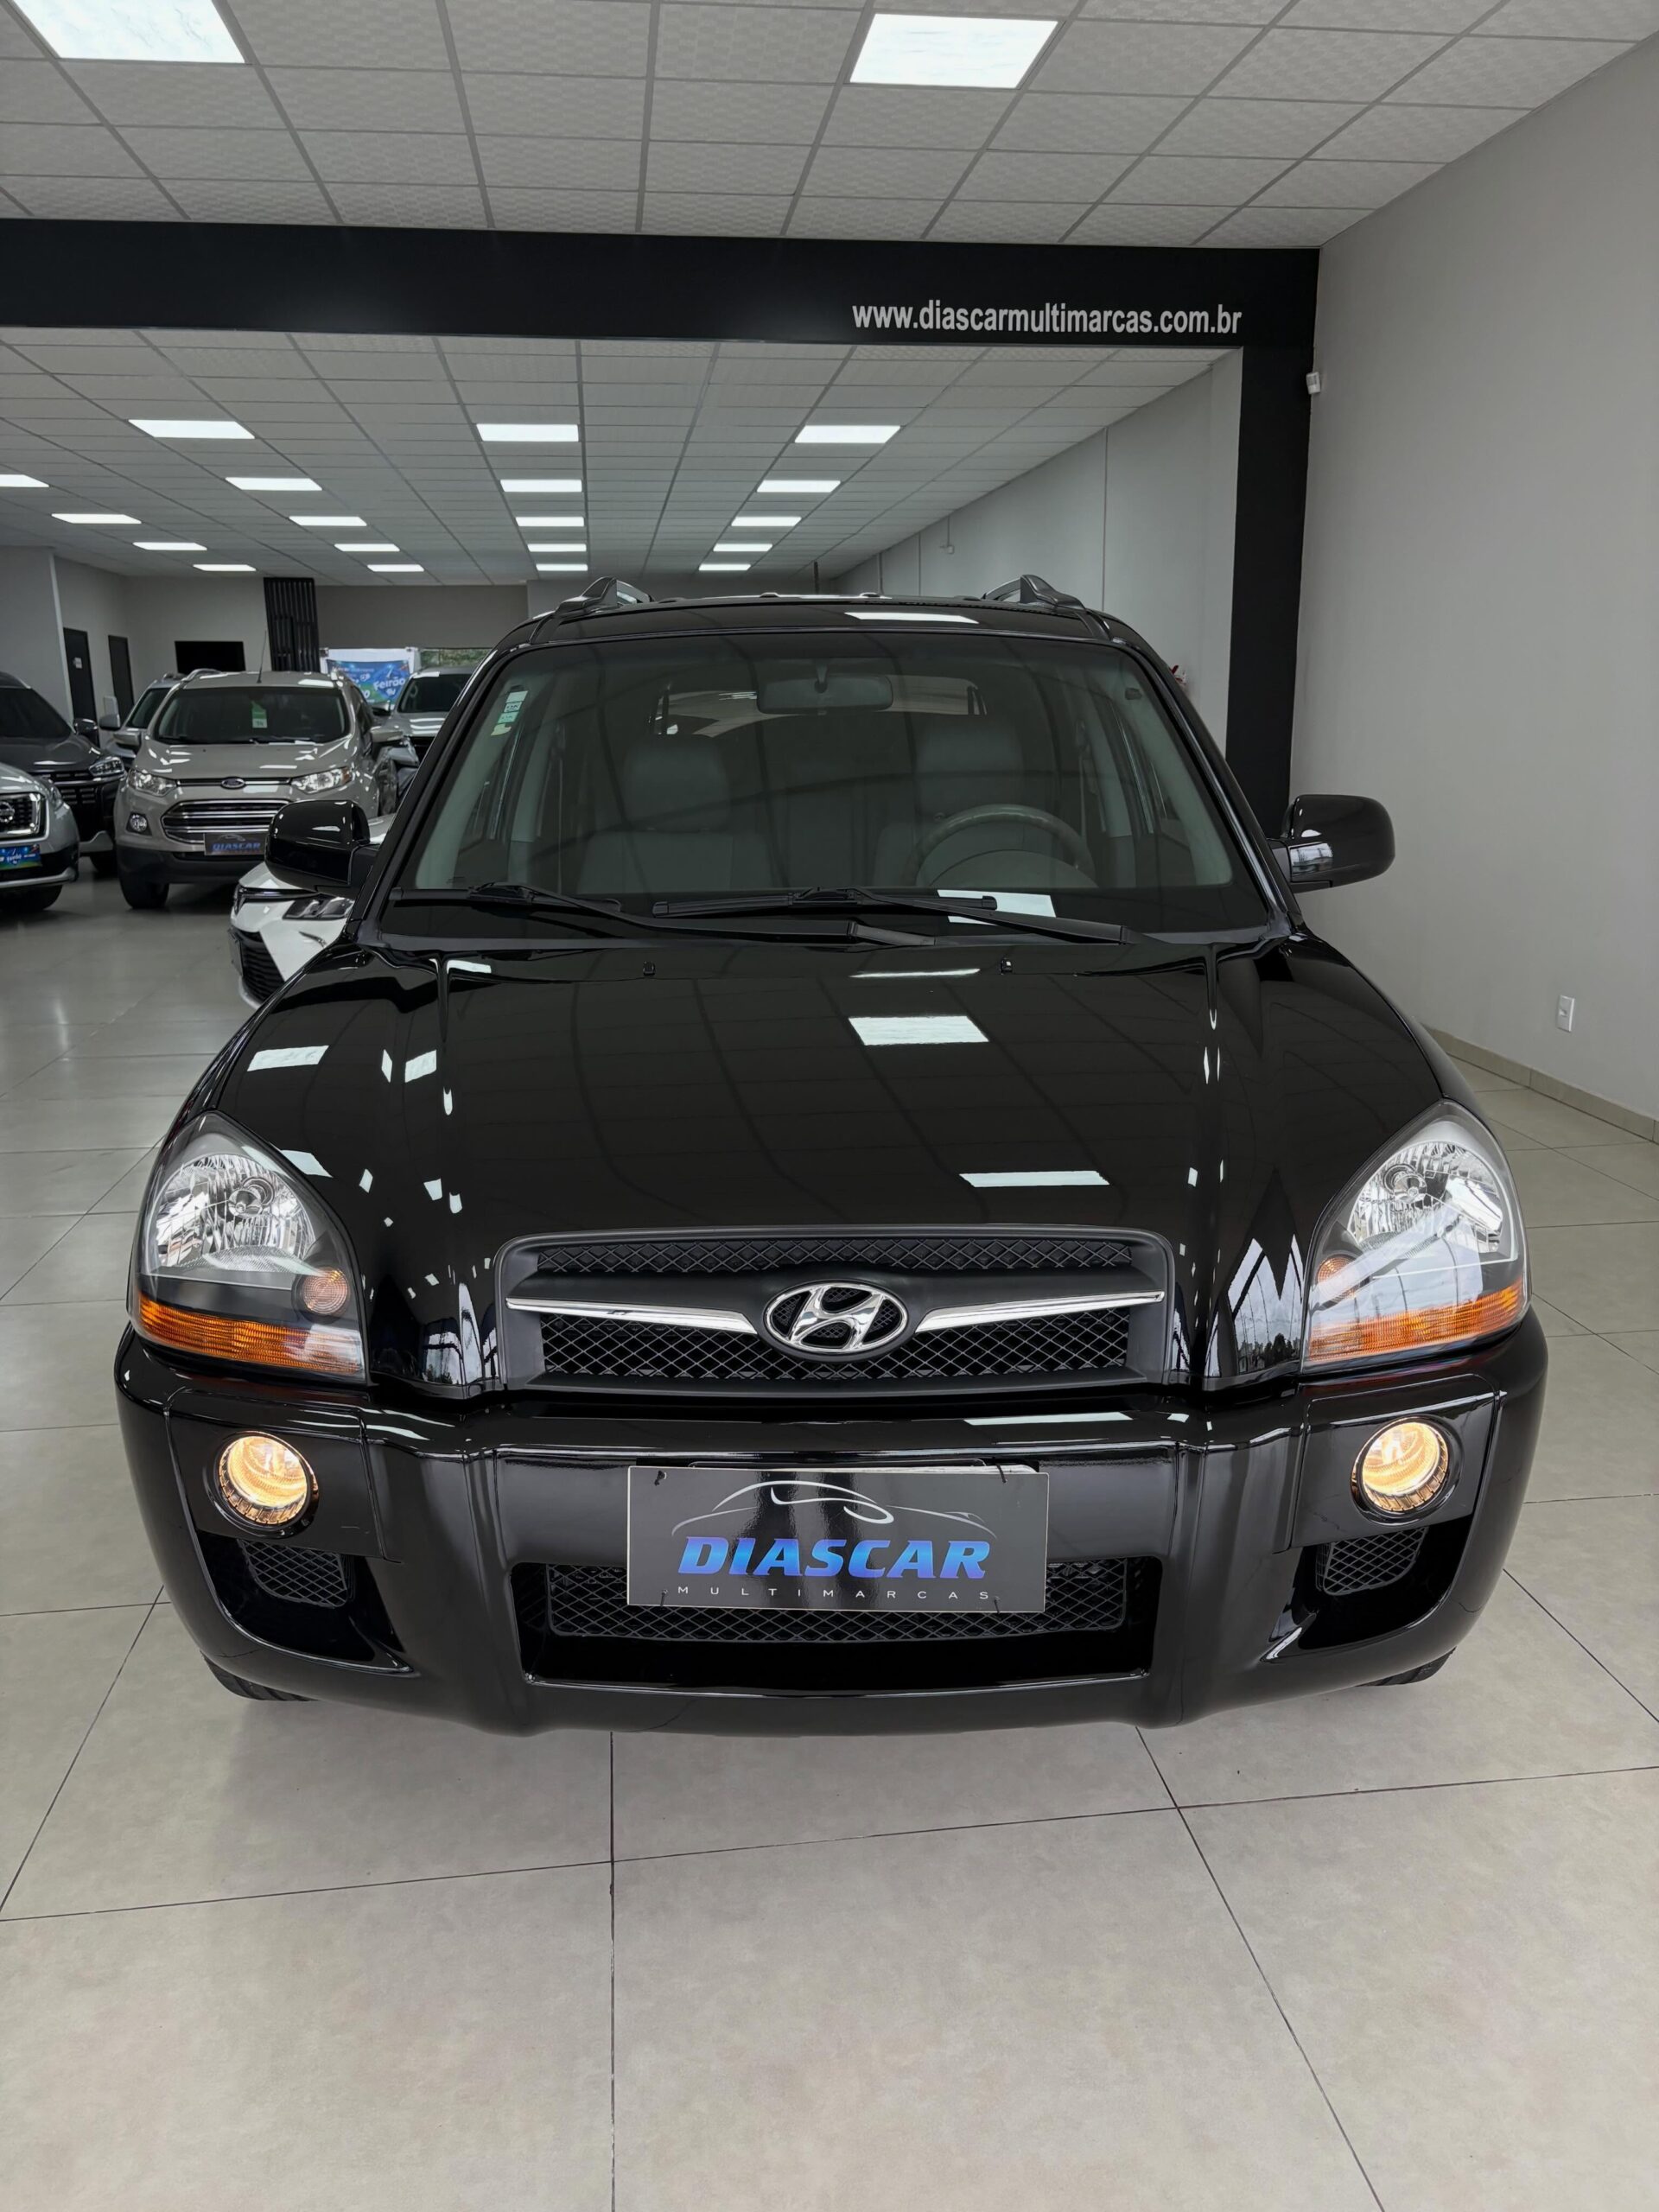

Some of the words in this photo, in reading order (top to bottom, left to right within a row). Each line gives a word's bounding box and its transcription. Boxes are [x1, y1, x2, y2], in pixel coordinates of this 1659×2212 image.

[852, 300, 1242, 334] www.diascarmultimarcas.com.br
[678, 1535, 990, 1580] DIASCAR
[678, 1586, 988, 1599] MULTIMARCAS
